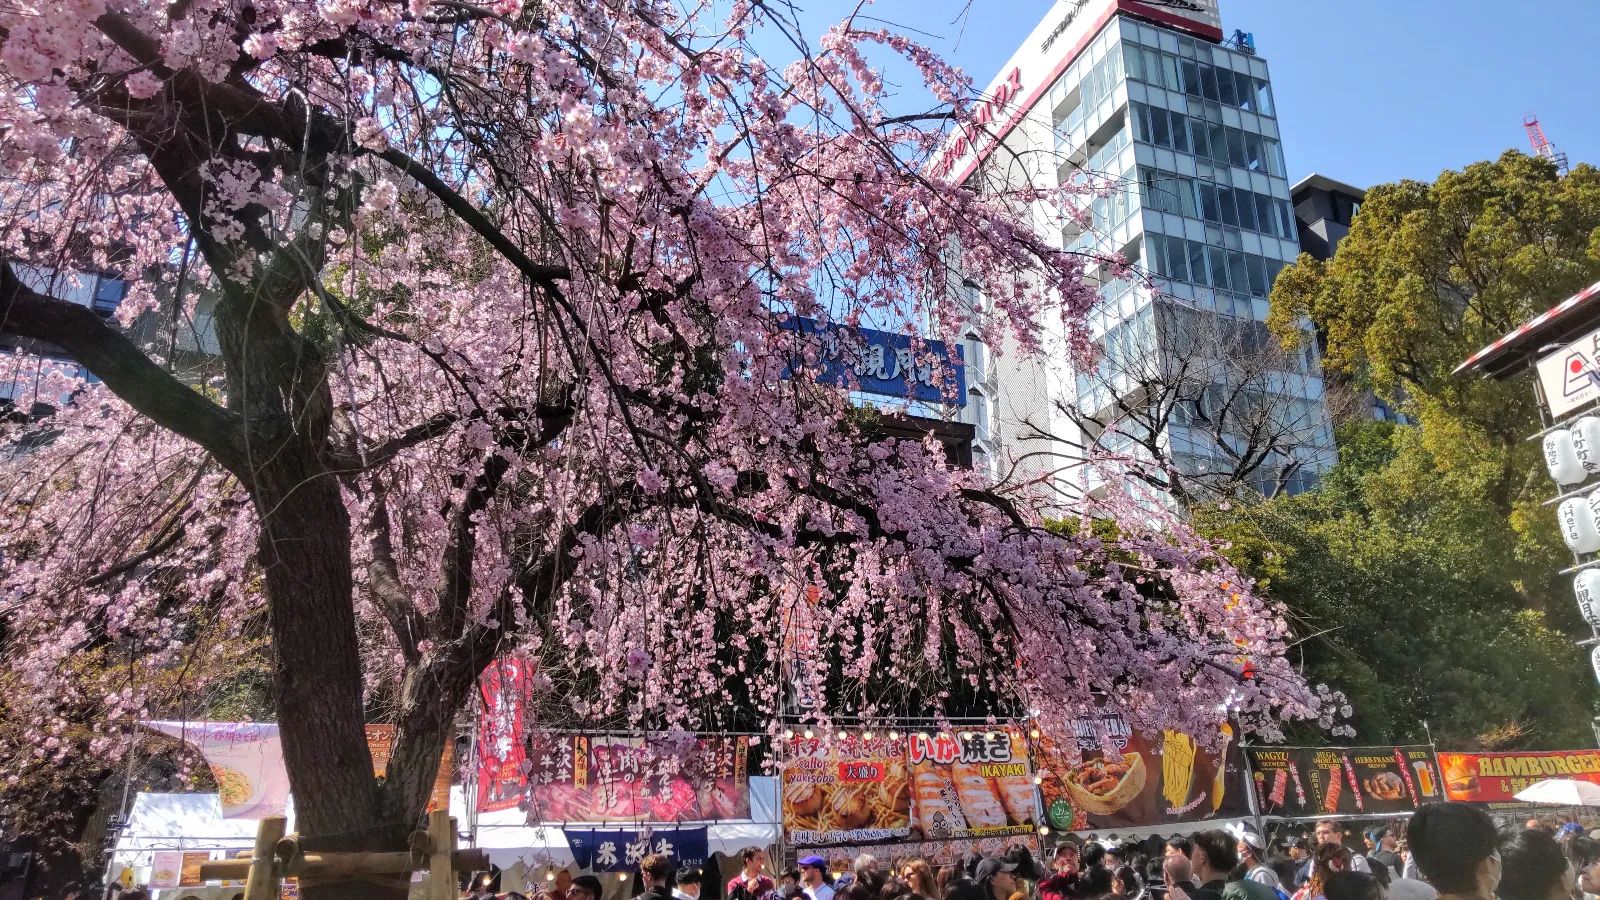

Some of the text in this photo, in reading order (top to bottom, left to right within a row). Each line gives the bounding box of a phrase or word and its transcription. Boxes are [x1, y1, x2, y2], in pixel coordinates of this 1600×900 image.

[908, 732, 1011, 764] いか焼き
[1408, 751, 1427, 759] BEER
[555, 737, 572, 783] 米沢牛
[717, 737, 733, 779] 米沢牛
[1255, 751, 1289, 761] WAGYU
[795, 757, 829, 770] scallop
[981, 763, 1026, 777] IKAYAKI
[789, 773, 835, 784] yakisoba
[846, 765, 878, 779] 大盛り
[596, 838, 675, 866] 米沢牛
